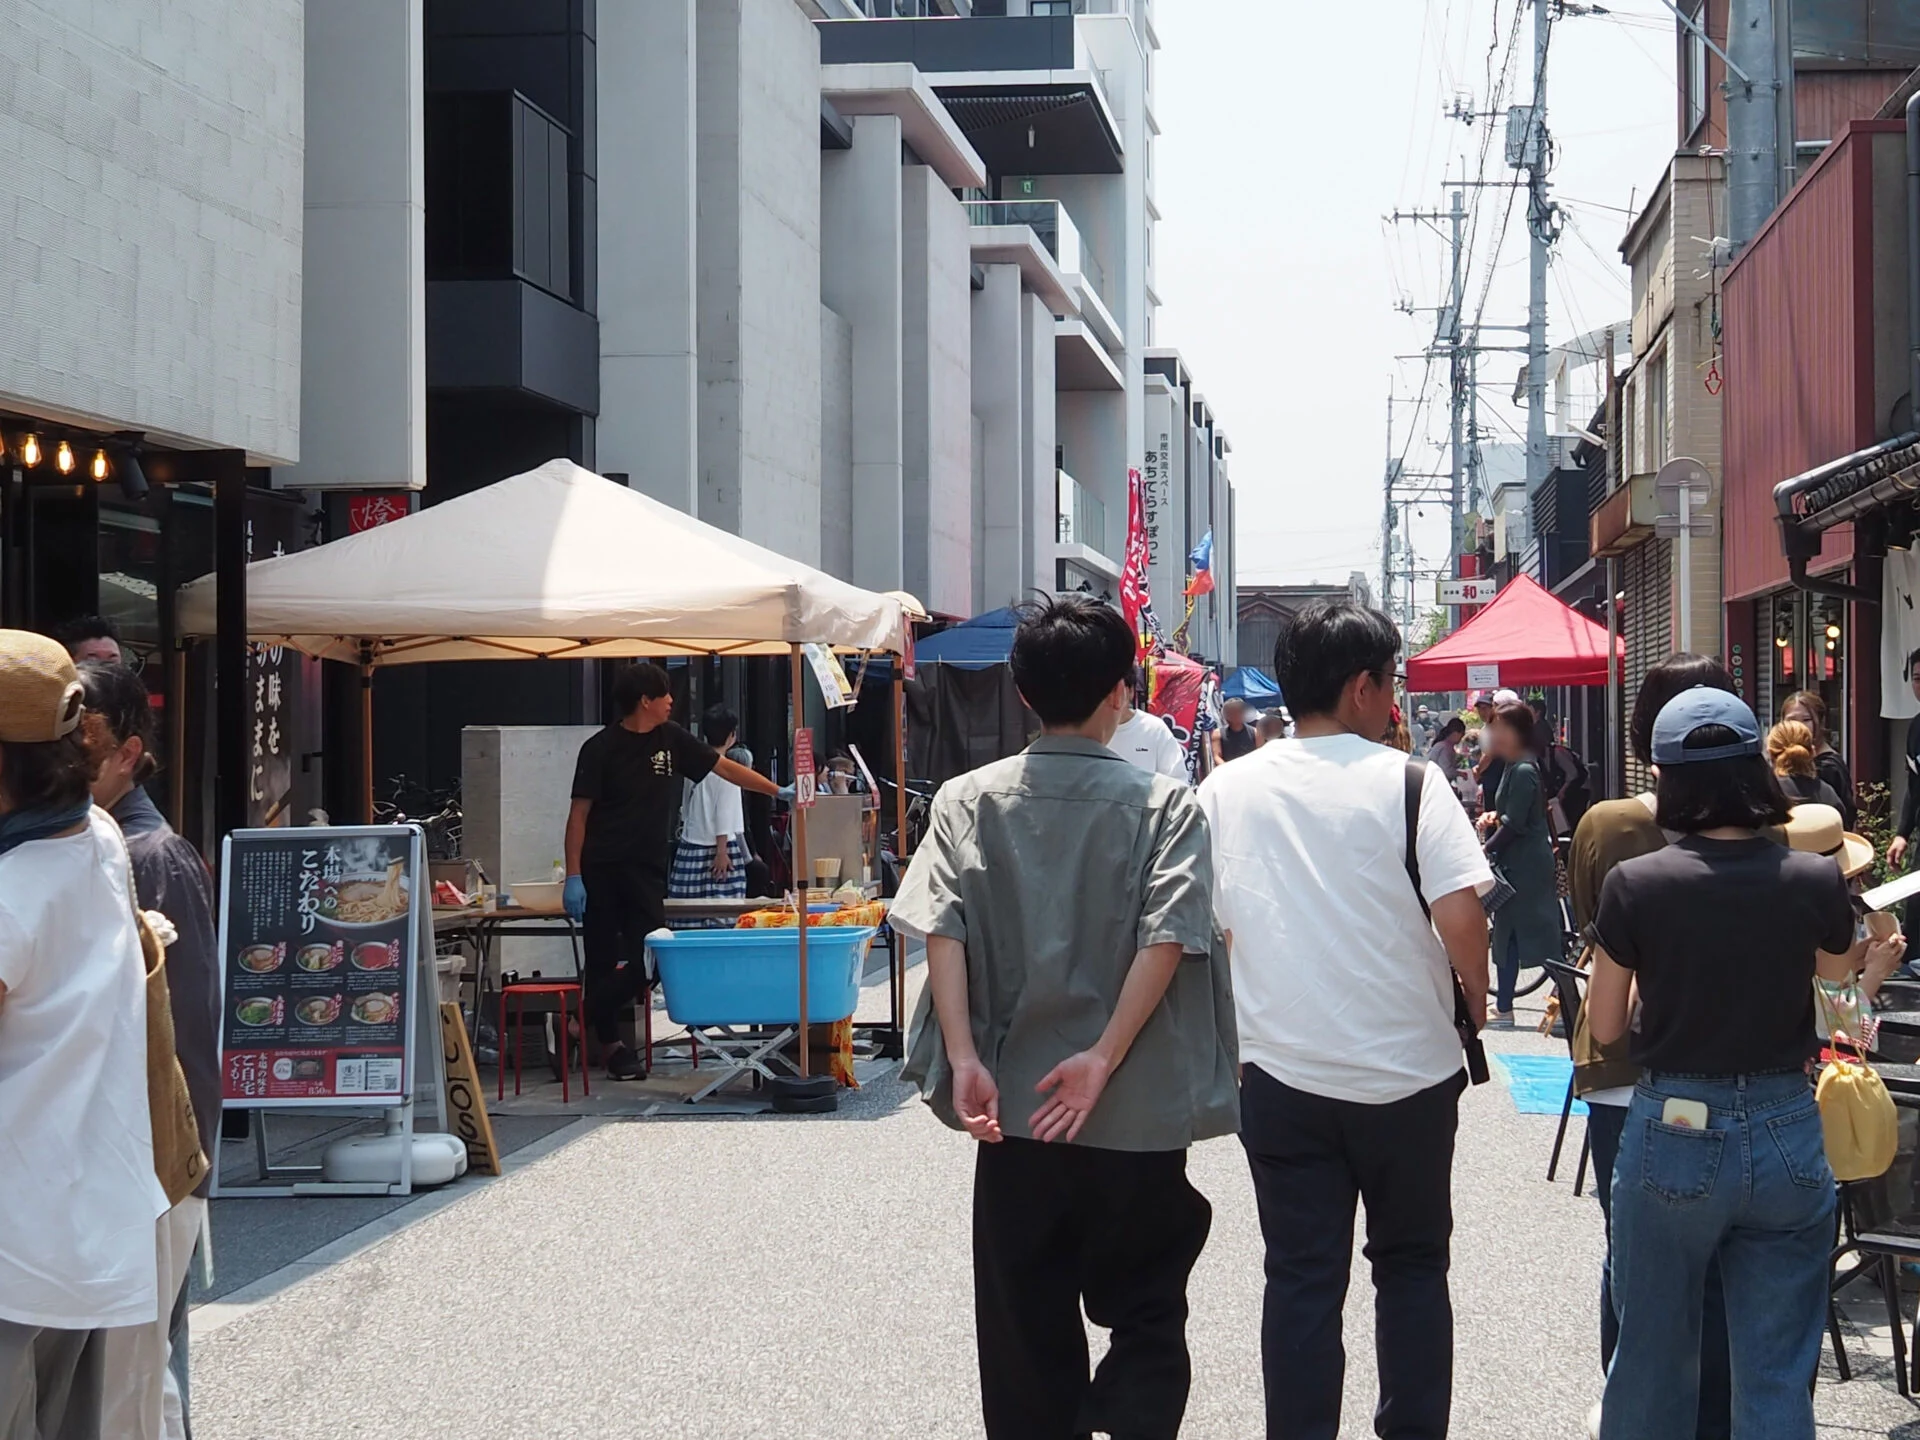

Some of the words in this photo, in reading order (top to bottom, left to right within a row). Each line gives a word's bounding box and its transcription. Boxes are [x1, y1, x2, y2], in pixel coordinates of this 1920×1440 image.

[1160, 433, 1168, 506] 市民交流スペース
[1144, 450, 1159, 566] あちてらすぽっと
[1462, 584, 1477, 600] 和
[296, 849, 321, 936] こだわり
[322, 846, 344, 909] 本場への
